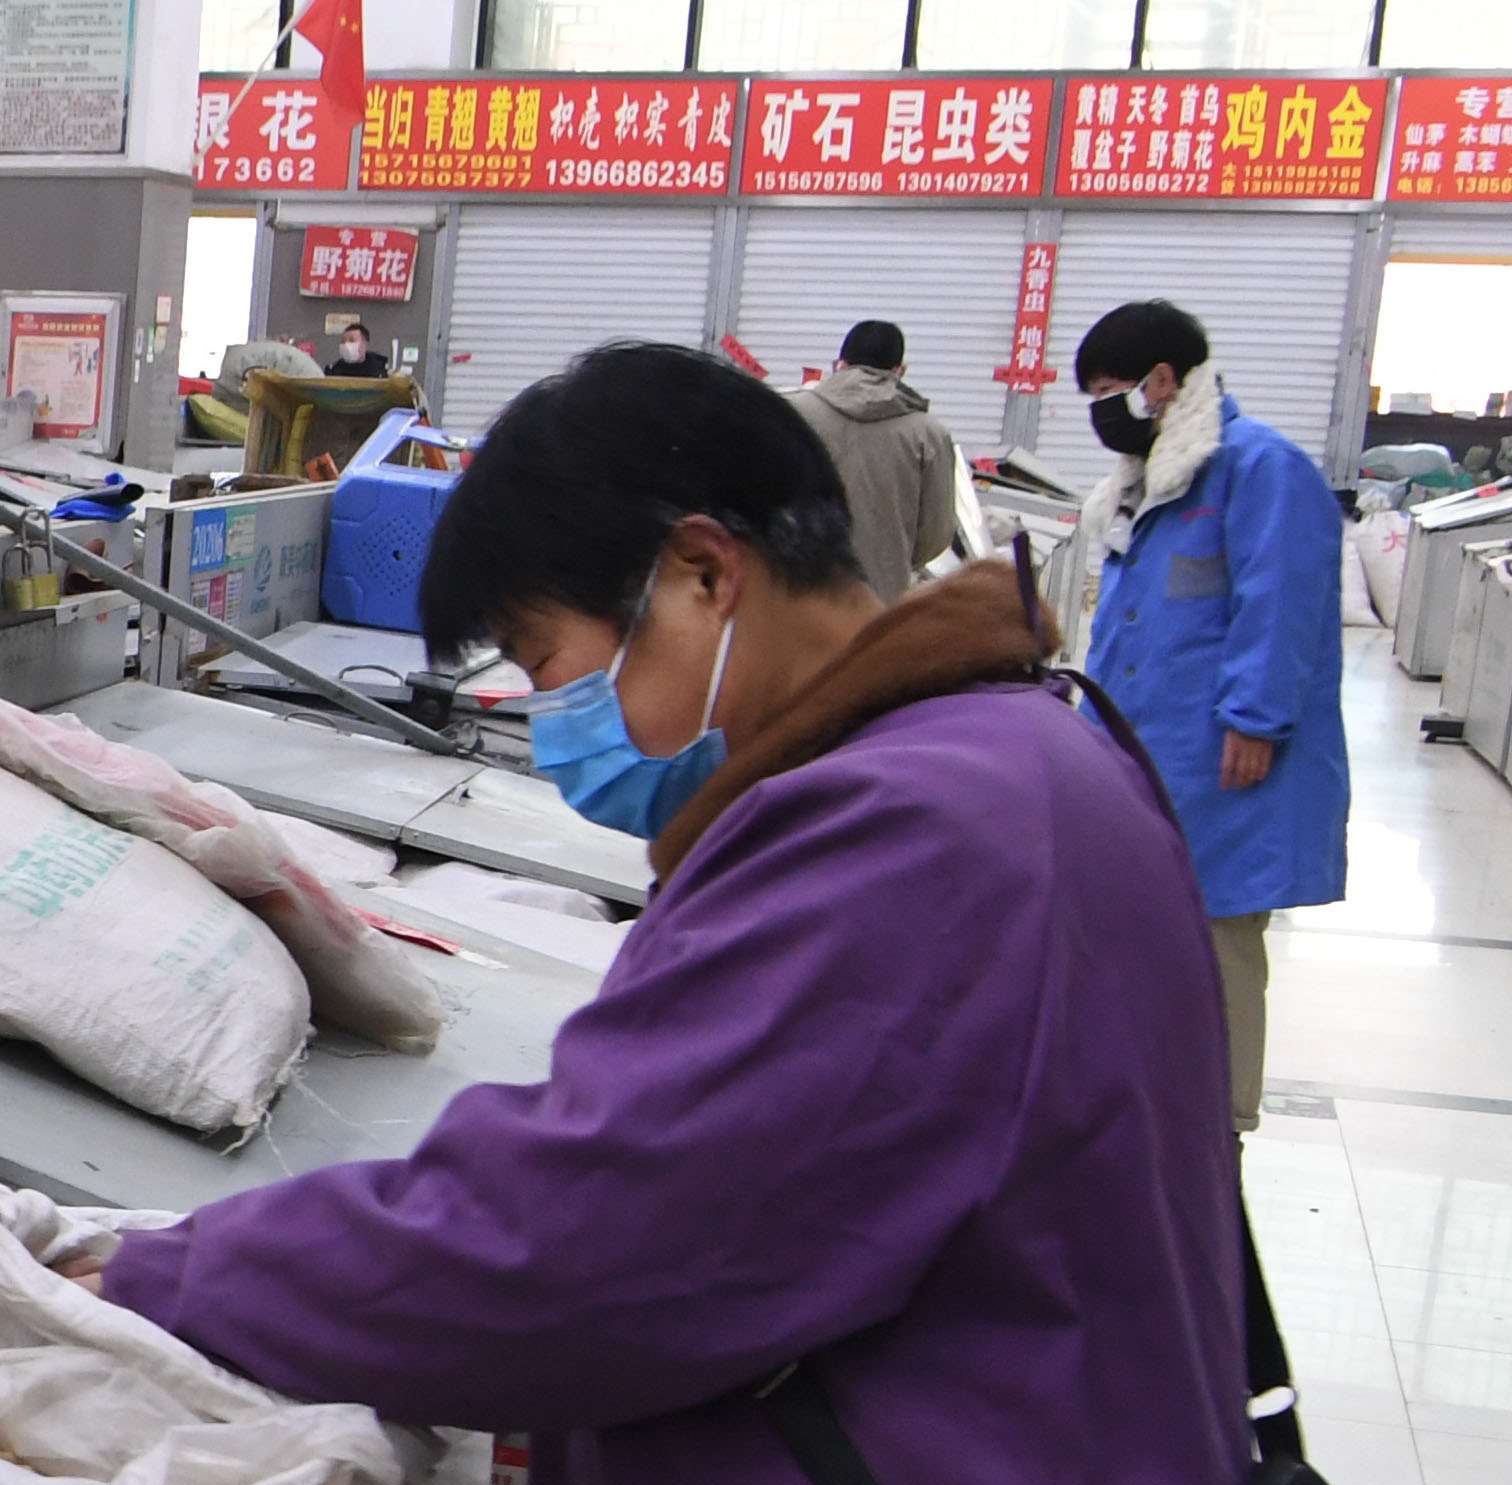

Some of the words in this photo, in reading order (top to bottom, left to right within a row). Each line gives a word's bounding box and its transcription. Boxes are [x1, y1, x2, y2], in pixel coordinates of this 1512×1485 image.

[362, 85, 414, 150] 当归
[678, 86, 731, 151] 青皮
[761, 88, 860, 163] 矿石
[881, 86, 1033, 165] 昆虫类
[1076, 83, 1118, 126] 黄精
[1127, 84, 1168, 125] 天冬
[1180, 84, 1219, 126] 首乌
[1221, 83, 1373, 160] 鸡内金
[1071, 129, 1136, 170] 覆盆子
[1147, 129, 1215, 171] 野菊花
[546, 158, 725, 188] 13966862345
[897, 172, 1029, 192] 13014079271
[310, 246, 408, 283] 野菊花
